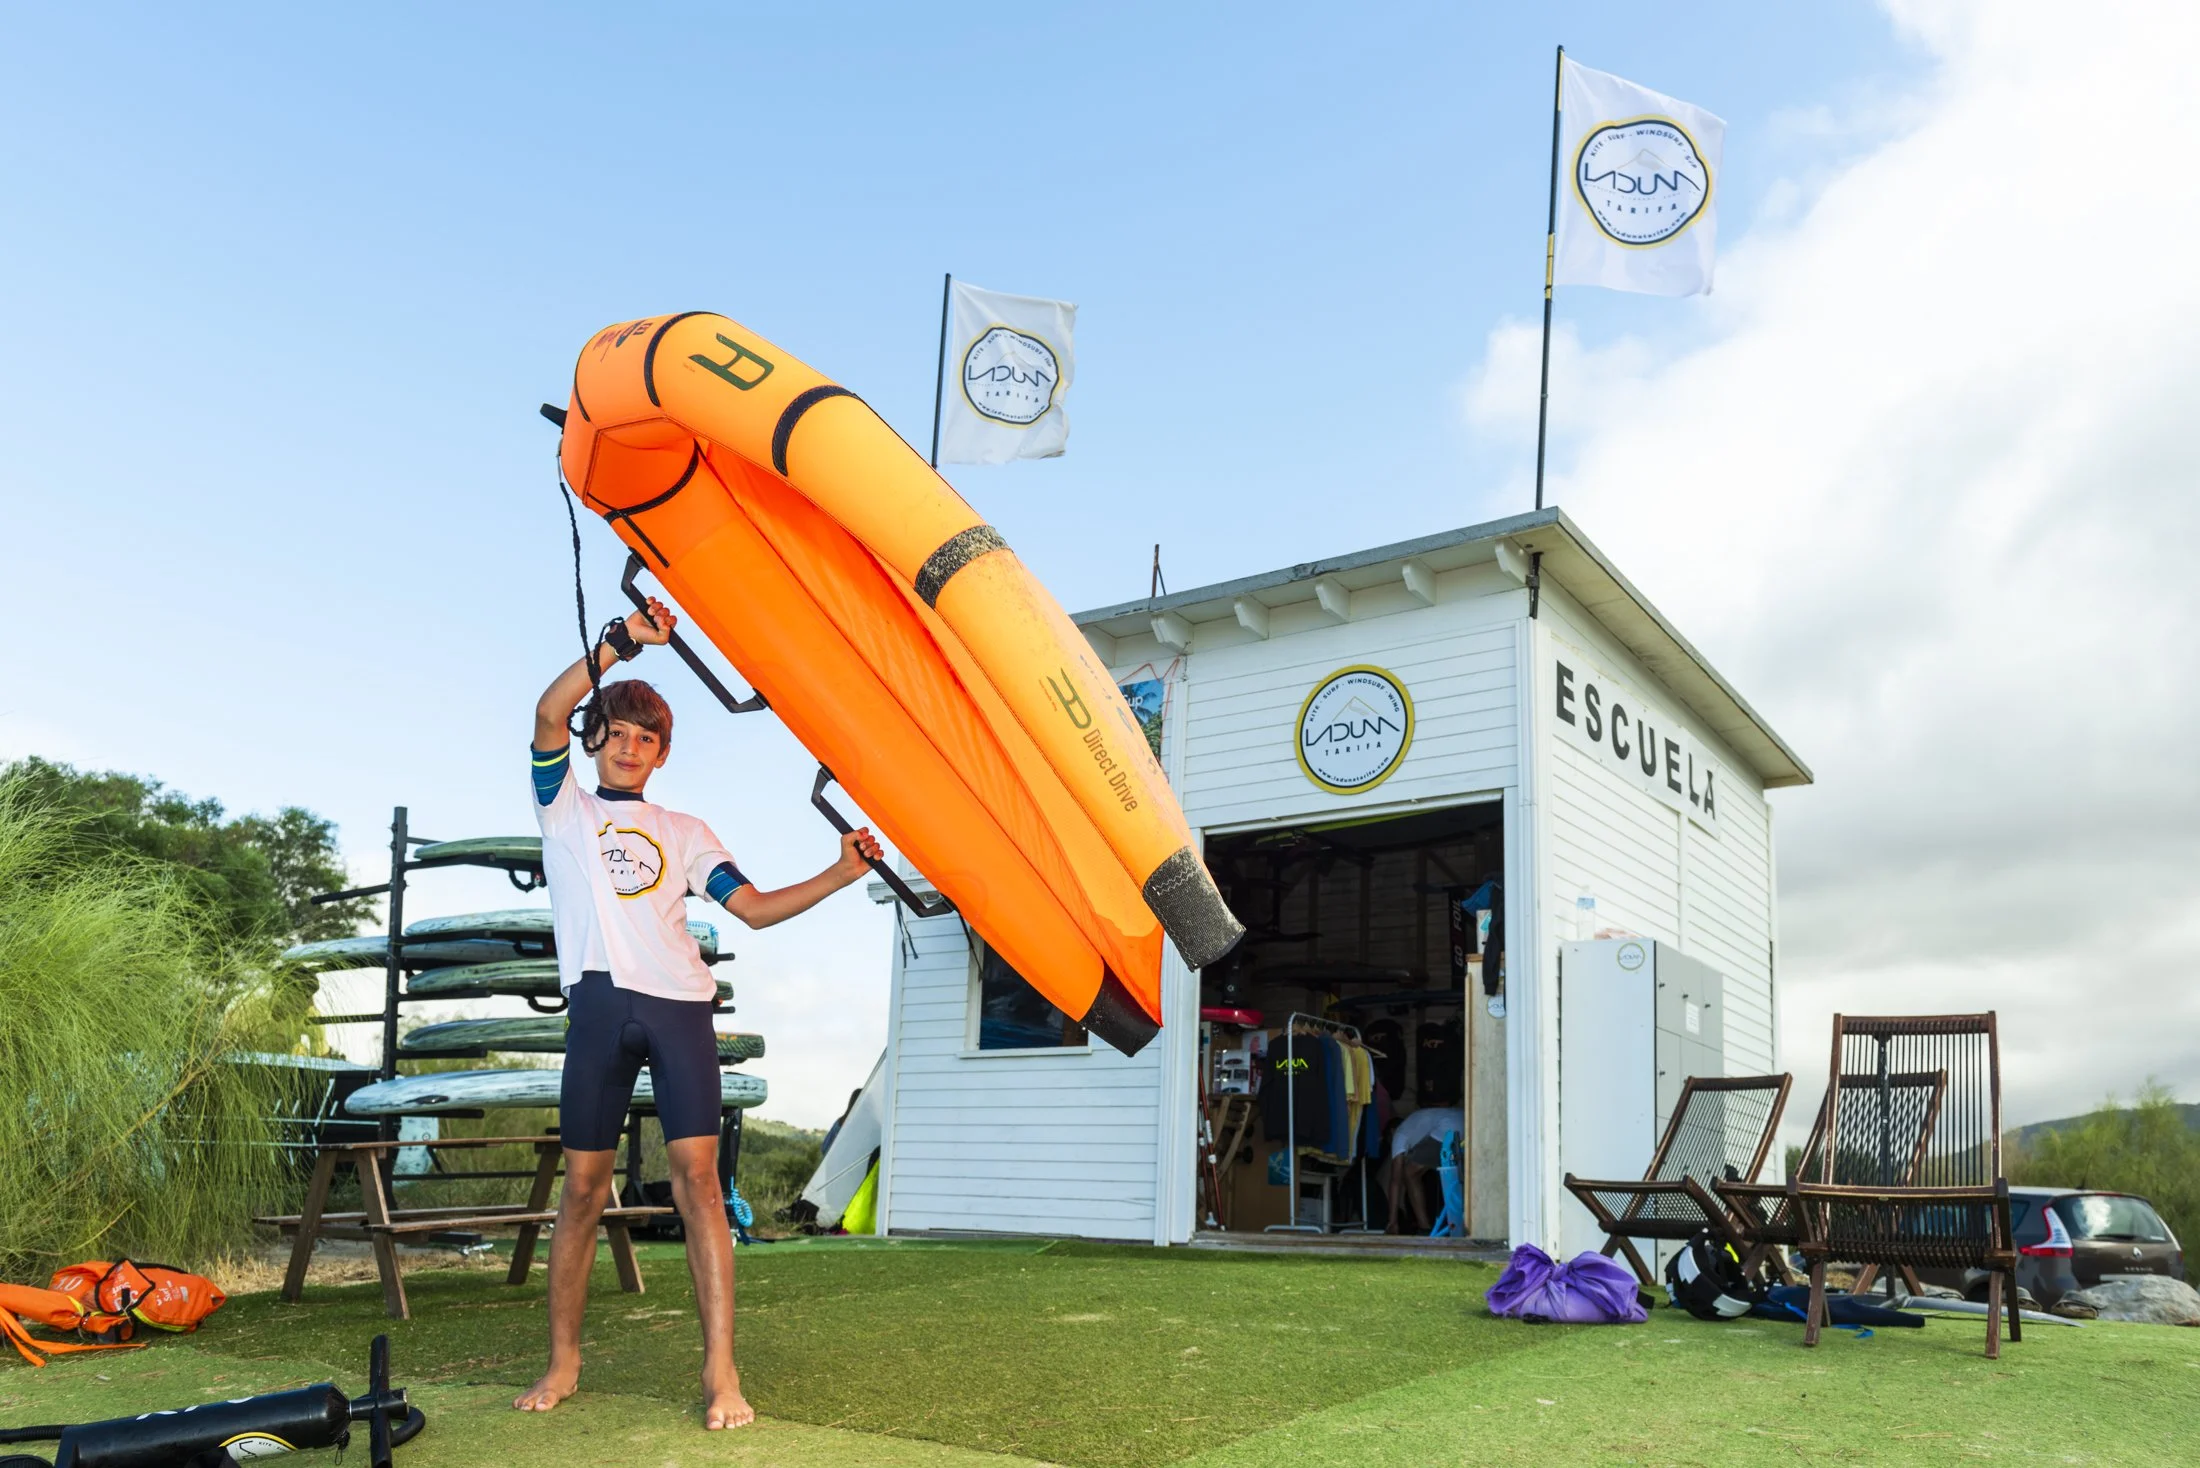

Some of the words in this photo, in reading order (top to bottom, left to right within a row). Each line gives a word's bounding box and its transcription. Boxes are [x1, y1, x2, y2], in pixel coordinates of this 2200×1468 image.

[1590, 142, 1605, 157] KITE
[1636, 129, 1684, 147] WINDSURF
[1606, 200, 1678, 214] TARIFA
[1309, 705, 1320, 722] KITE
[1323, 685, 1340, 700] SURF
[1347, 678, 1385, 690] WINDSURF
[1387, 693, 1400, 713] WING
[1325, 741, 1381, 756] TARIFA
[1556, 659, 1716, 821] ESCUELA
[1083, 728, 1118, 775] Direct
[1108, 771, 1138, 812] Drive
